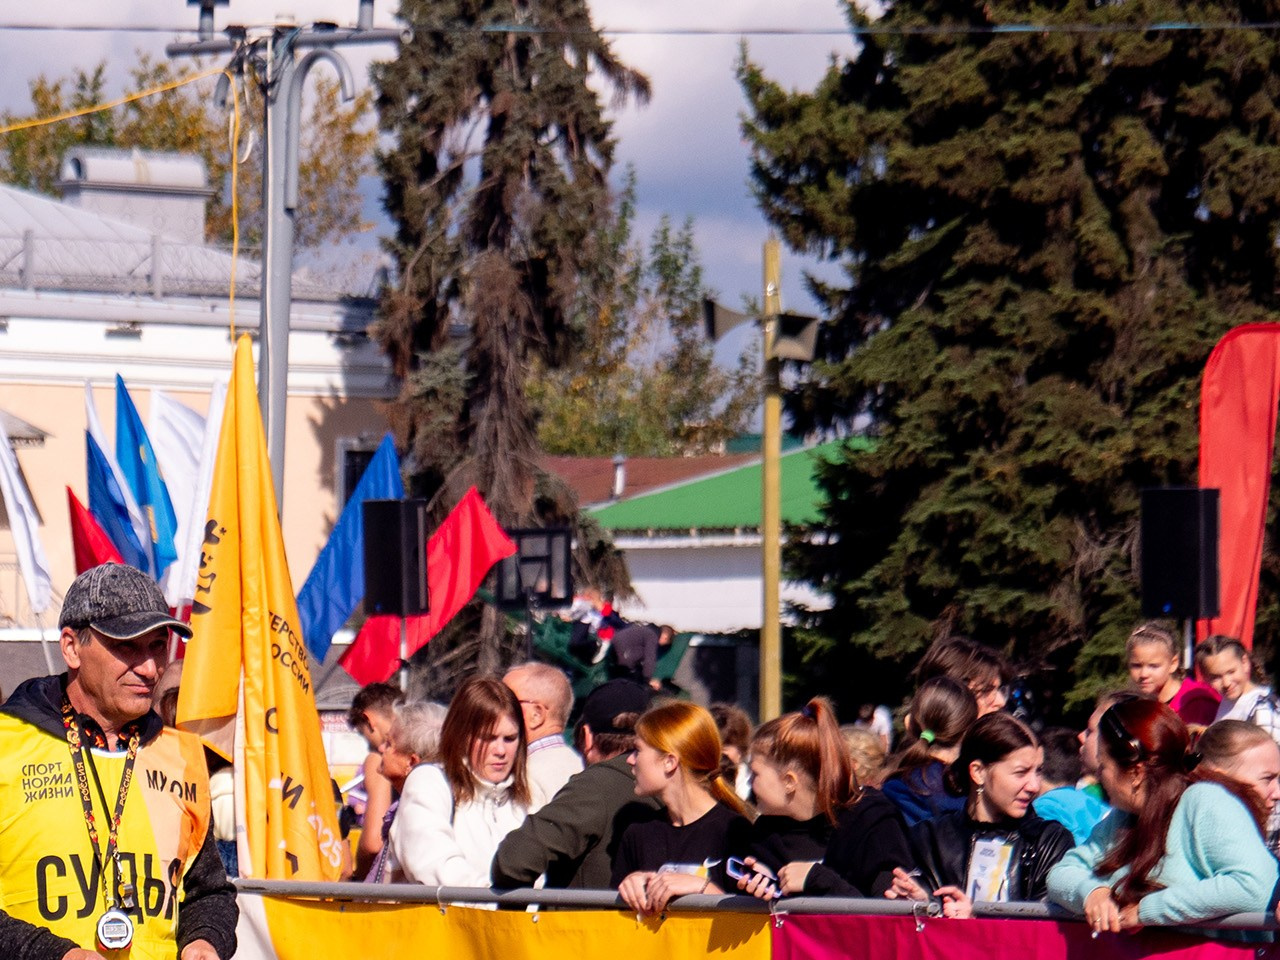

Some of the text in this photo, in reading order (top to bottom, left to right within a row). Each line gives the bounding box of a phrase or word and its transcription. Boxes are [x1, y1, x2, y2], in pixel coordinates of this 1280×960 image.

[271, 643, 310, 695] ОССИИ
[21, 761, 62, 777] СПОРТ
[22, 772, 72, 790] НОРМА
[76, 761, 90, 802] РОССИЯ
[119, 767, 132, 806] РОССИЯ
[145, 768, 197, 803] МУОМ
[24, 786, 74, 803] ЖИЗНИ
[36, 851, 181, 924] СУДЬЯ
